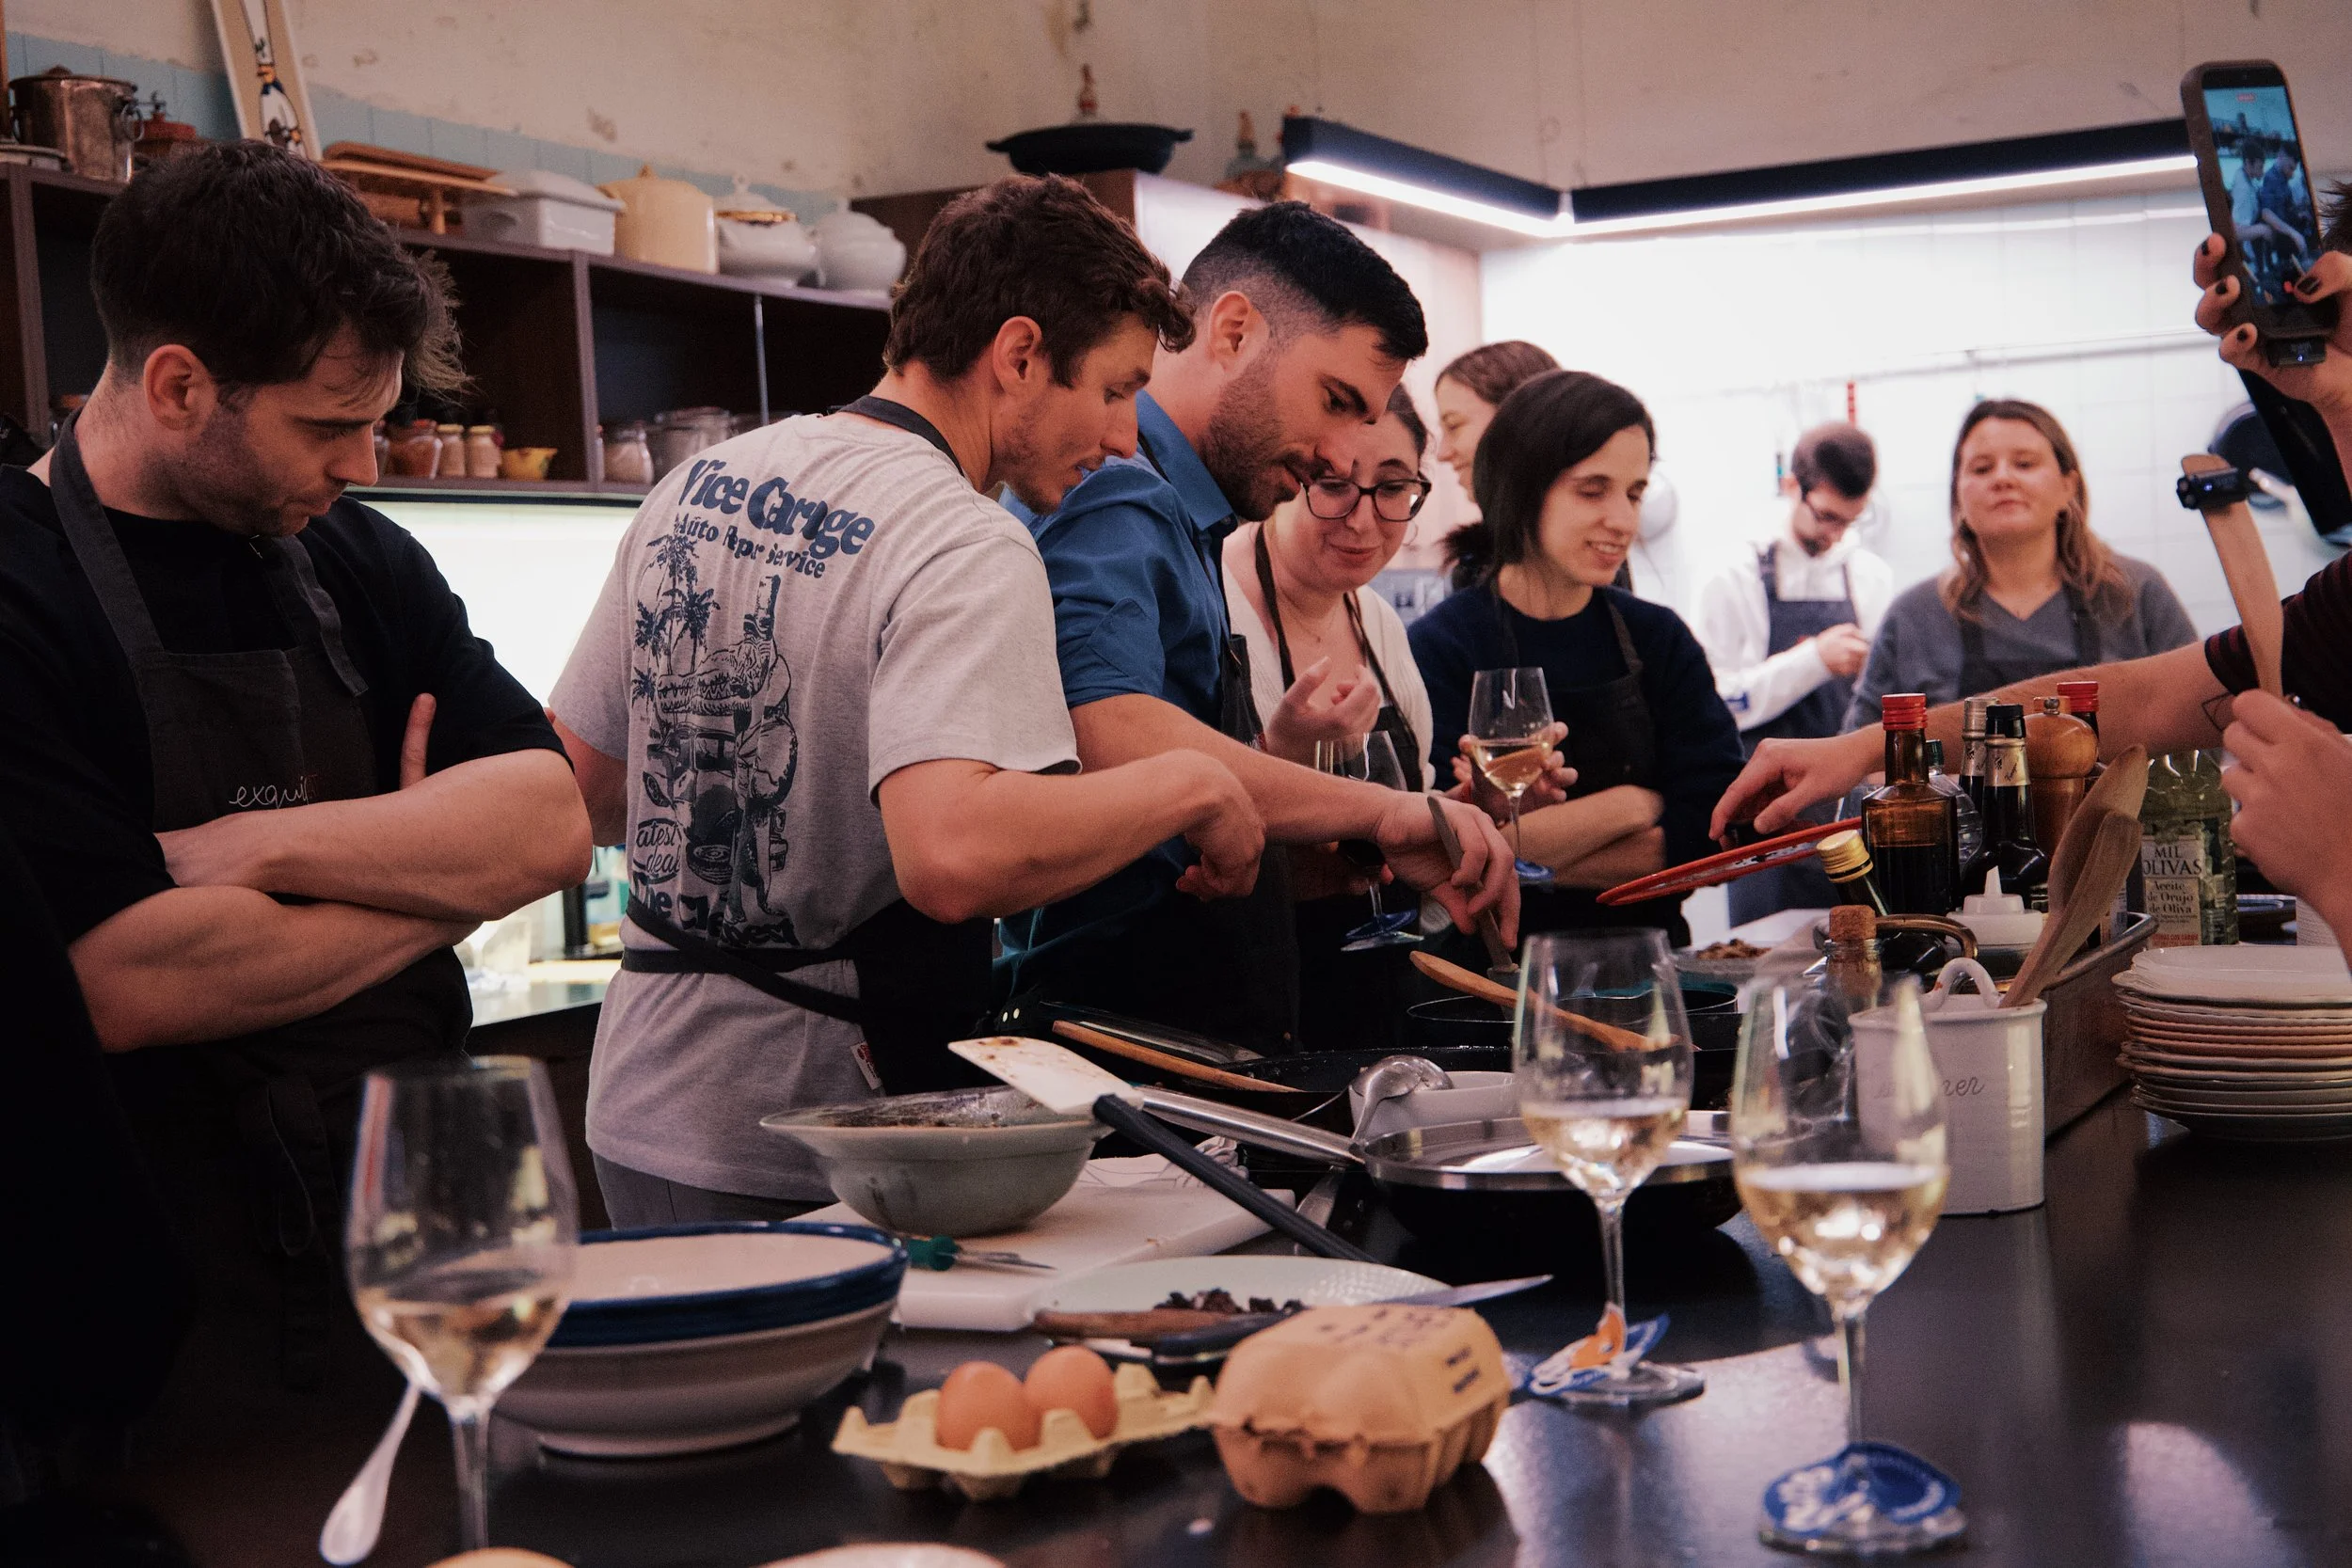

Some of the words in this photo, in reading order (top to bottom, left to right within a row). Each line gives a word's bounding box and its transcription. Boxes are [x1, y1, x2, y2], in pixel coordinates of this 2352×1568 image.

[678, 459, 750, 515] Vice
[635, 821, 678, 847] atest
[2154, 847, 2183, 858] MIL
[2143, 858, 2202, 876] OLIVAS
[2163, 903, 2192, 914] Oliva
